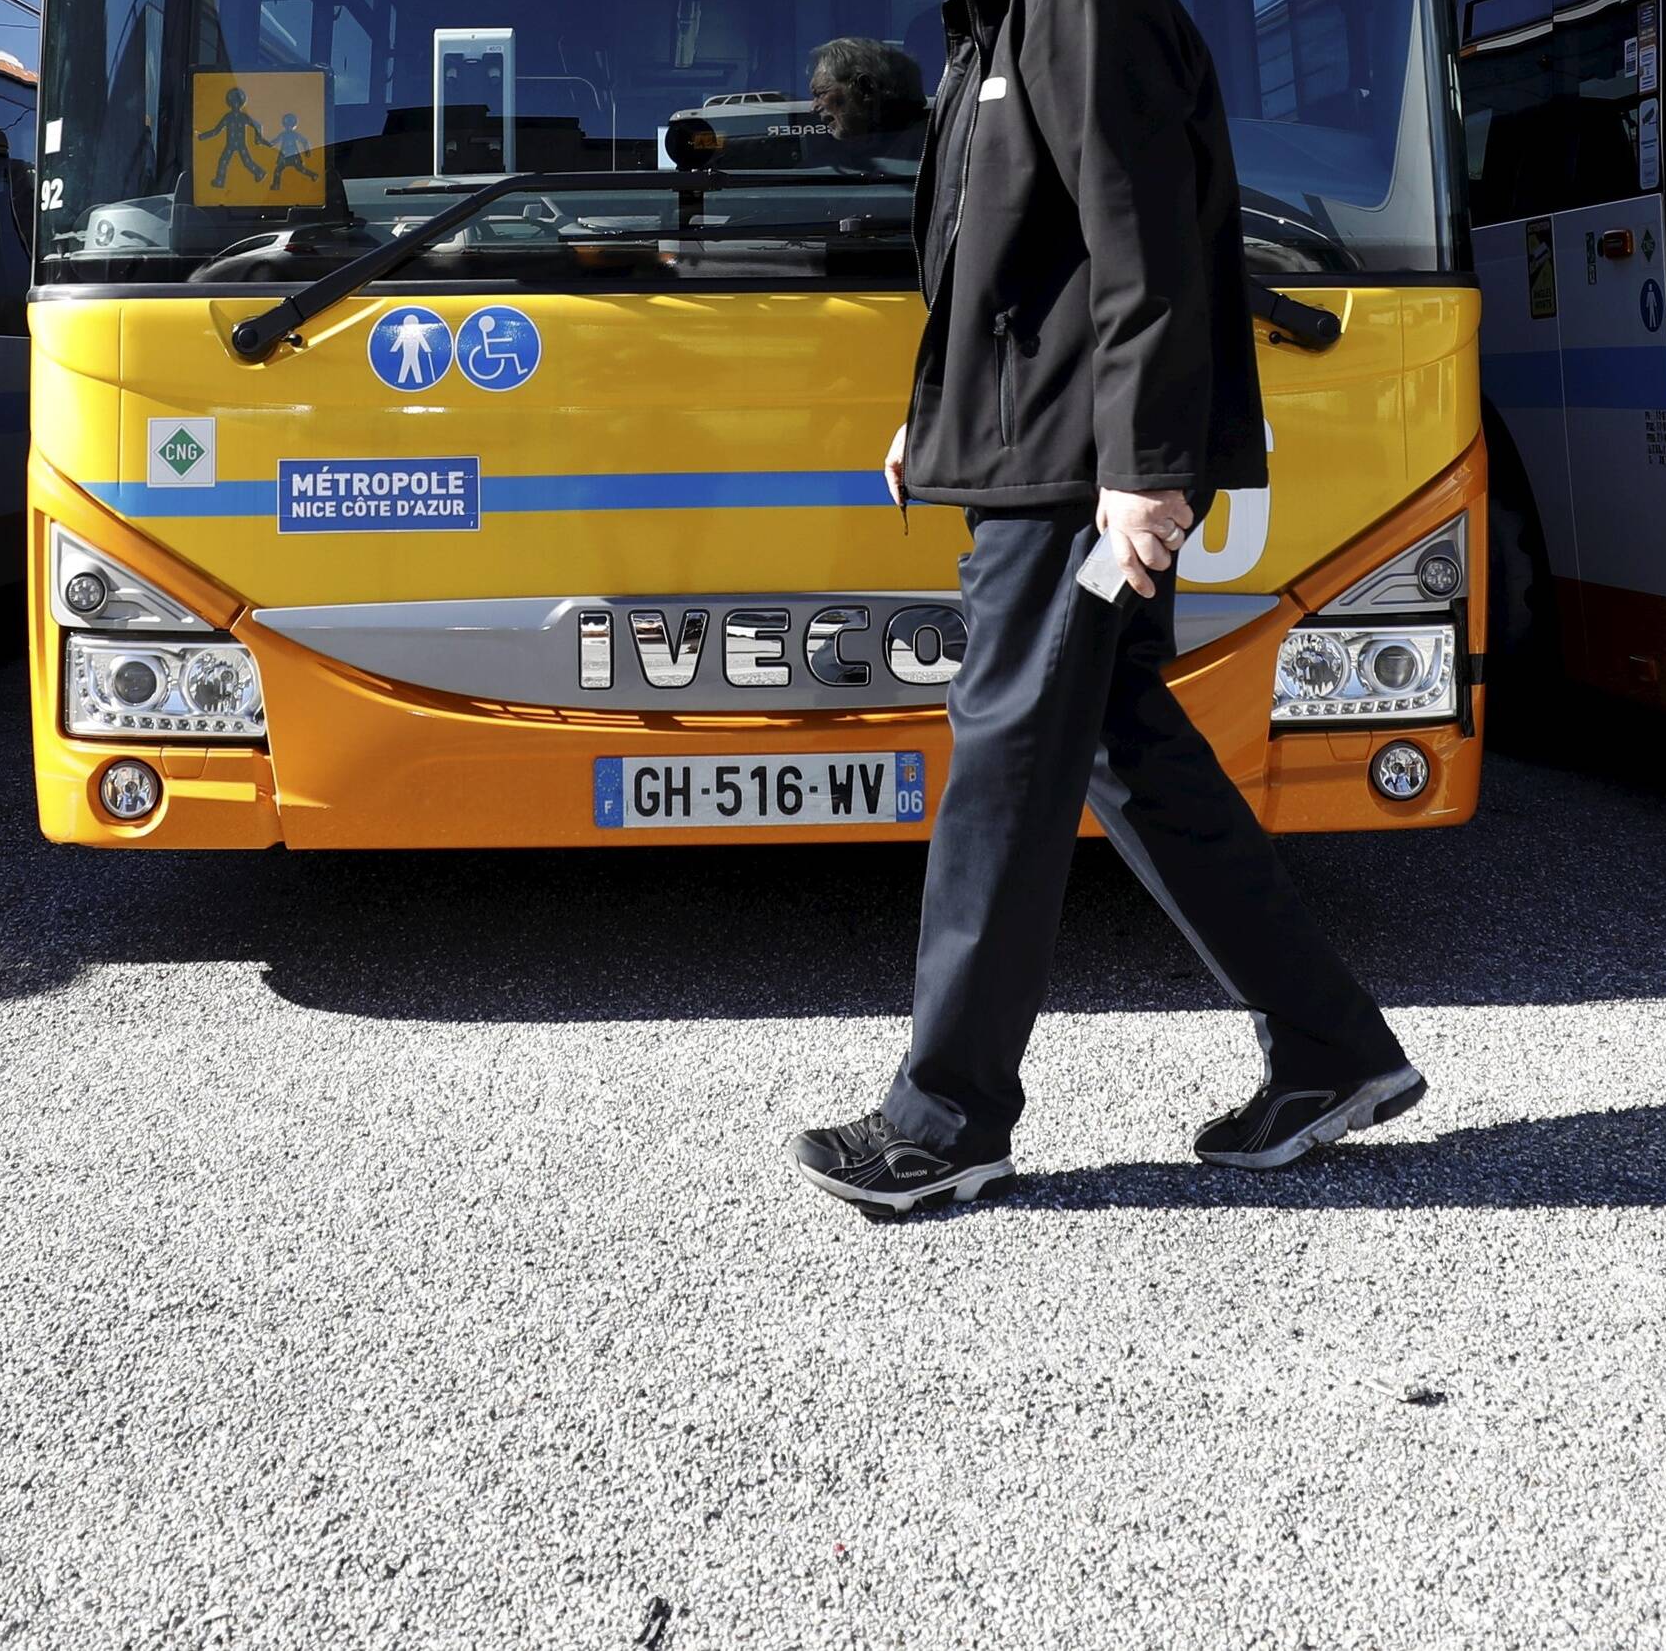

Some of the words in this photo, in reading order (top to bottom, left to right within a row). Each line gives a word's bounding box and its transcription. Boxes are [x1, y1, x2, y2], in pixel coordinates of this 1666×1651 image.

[40, 177, 64, 211] 92
[166, 444, 197, 460] CNG
[292, 466, 465, 496] MÉTROPOLE
[292, 502, 336, 518] NICE
[342, 497, 391, 517] CÔTE
[397, 500, 465, 516] D'AZUR
[577, 604, 967, 691] IVECO
[604, 800, 613, 814] F
[633, 763, 885, 817] GH-516-WV
[897, 790, 923, 814] 06
